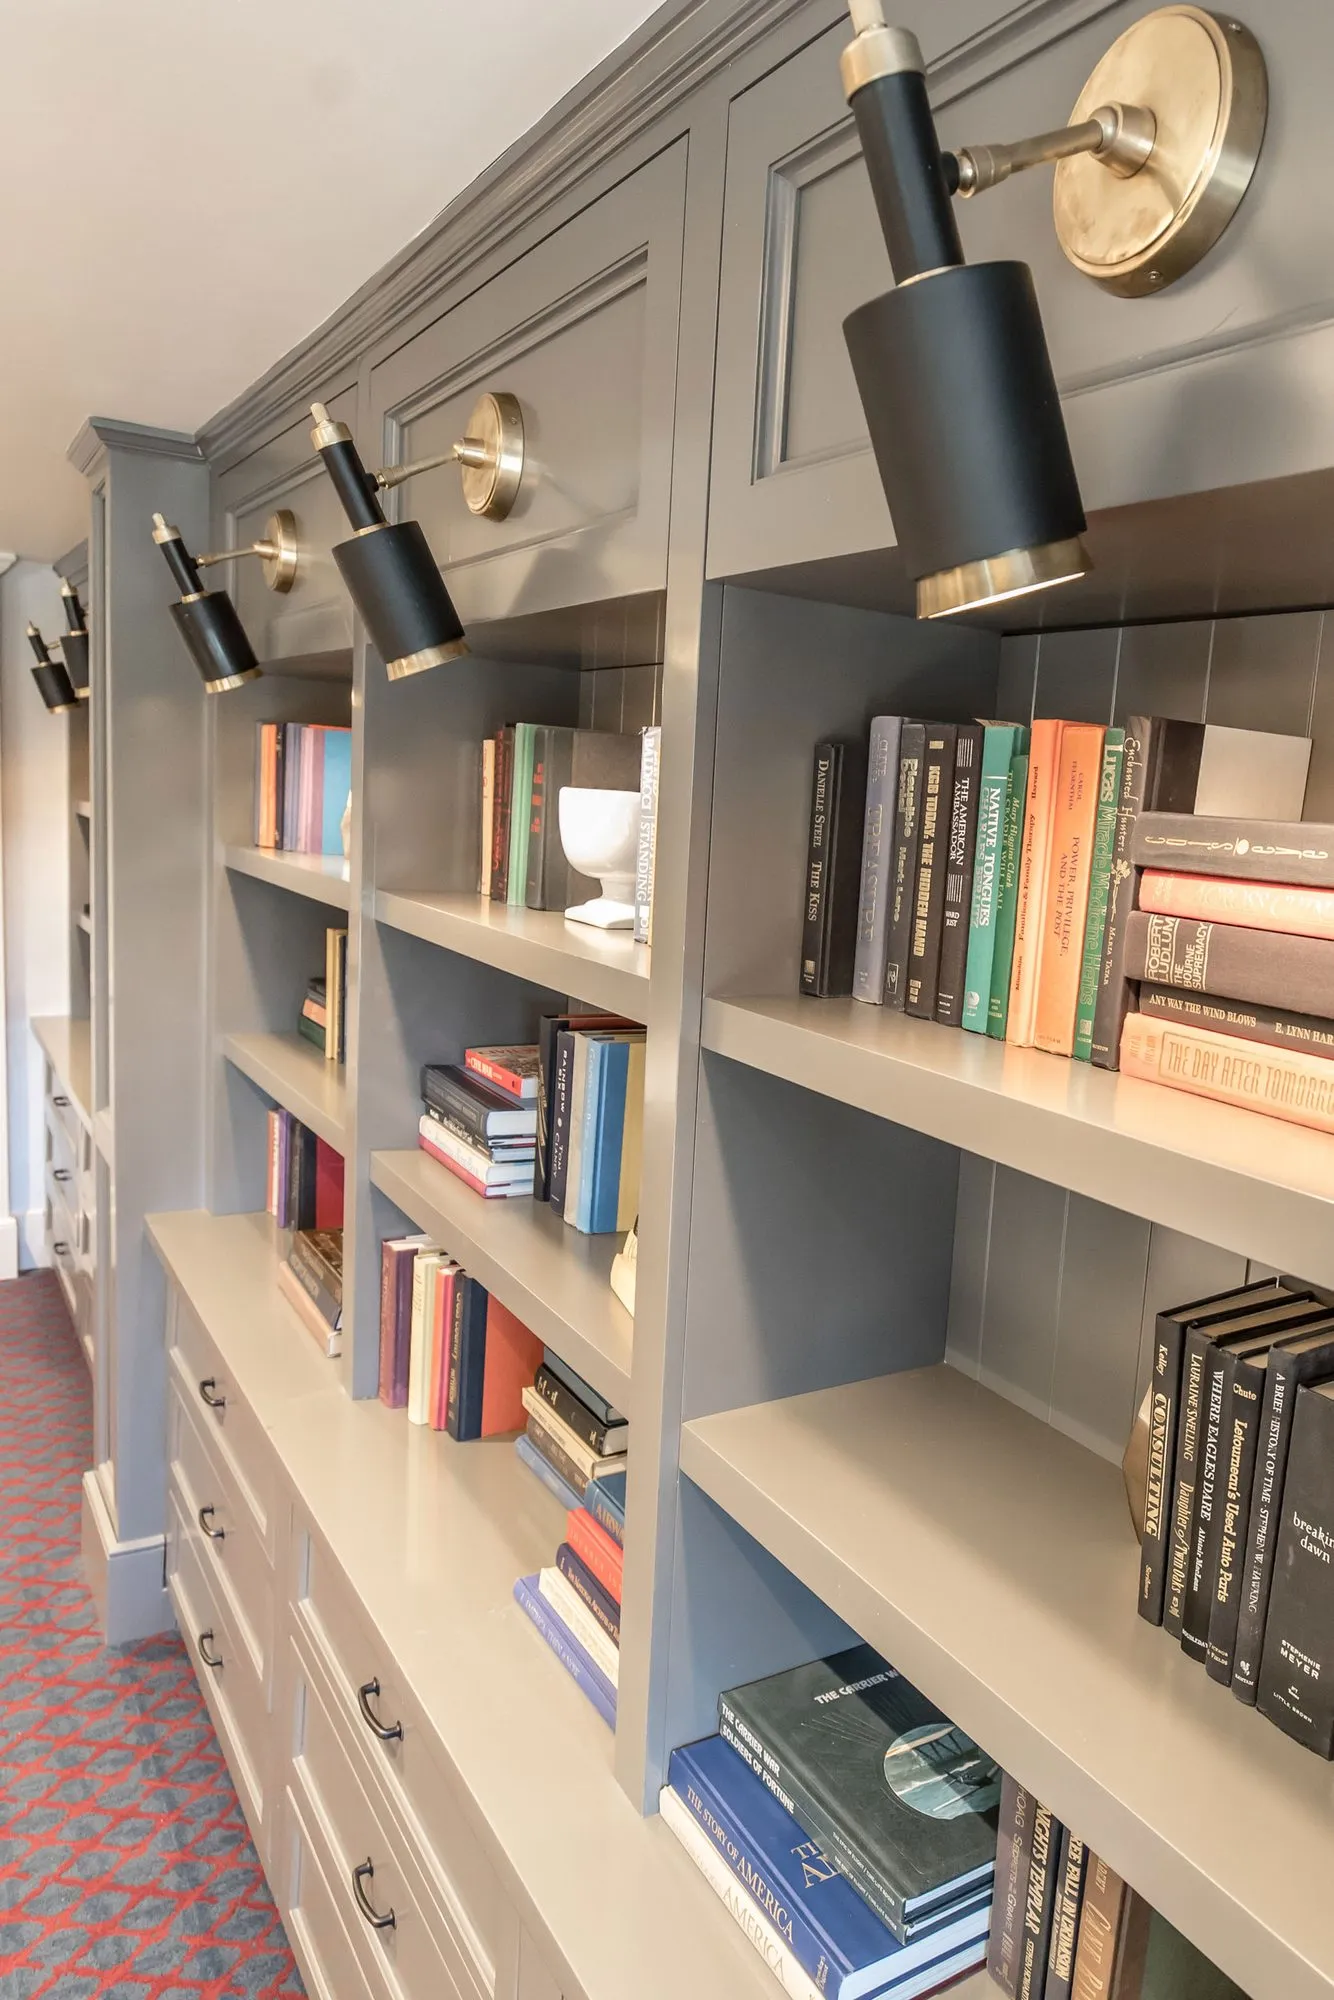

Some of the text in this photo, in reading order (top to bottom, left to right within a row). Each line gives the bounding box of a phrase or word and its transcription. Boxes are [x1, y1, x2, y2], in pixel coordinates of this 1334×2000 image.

[812, 759, 830, 848] DANIELLE STEEL
[904, 758, 919, 838] Plausible
[927, 765, 941, 794] KGB
[1031, 766, 1039, 799] Harvard
[1116, 737, 1143, 853] Enchanted Hunters
[921, 842, 934, 866] THE
[950, 781, 961, 860] AMBASSADOR
[956, 777, 970, 866] THE AMERICAN
[976, 786, 990, 860] CHARLES
[1005, 797, 1020, 888] Mary Higgins Clark
[637, 821, 651, 902] STANDING
[808, 860, 822, 921] THE KISS
[860, 803, 884, 941] TREASURE
[894, 846, 907, 922] Mark Lane
[979, 787, 1001, 927] NATIVE TONGUES
[1079, 744, 1124, 1006] Lucas Miracle Medicine Herbs
[917, 867, 932, 917] HIDDEN
[1053, 853, 1068, 936] AND THE POST
[1059, 836, 1080, 957] POWER, PRIVILEGE,
[913, 918, 927, 957] HAND
[1103, 926, 1117, 986] MARIA TATAR
[1147, 914, 1164, 981] ROBERT
[1158, 917, 1177, 984] LUDLUM
[1183, 943, 1196, 988] BOURNE
[1192, 922, 1210, 990] SUPREMACY
[1173, 963, 1184, 985] THE
[1149, 993, 1257, 1028] ANY WAY THE WIND BLOWS
[1275, 1022, 1285, 1034] E.
[1285, 1024, 1311, 1041] LYNN
[560, 1049, 568, 1113] RAINBOW
[1167, 1041, 1189, 1075] THE
[1191, 1047, 1219, 1084] DAY
[1220, 1055, 1262, 1095] AFTER
[1156, 1344, 1168, 1376] Kelley
[1232, 1382, 1257, 1401] Chute
[1183, 1353, 1203, 1461] LAURAINE SNELLING
[1261, 1372, 1286, 1504] A BRIEF HISTORY OF TIME
[1146, 1393, 1167, 1537] CONSULTING
[1200, 1369, 1225, 1521] WHERE EAGLES DARE
[1171, 1480, 1194, 1594] Daughter of Twin Oaks
[1196, 1526, 1206, 1558] Alistair
[1217, 1418, 1248, 1603] Letourneau's Used Auto Parts
[1248, 1508, 1269, 1614] STEPHEN W. HAWKING
[1300, 1535, 1331, 1564] dawn
[1280, 1648, 1320, 1680] MEYER
[1281, 1639, 1321, 1671] STEPHENIE
[814, 1690, 841, 1705] THE
[841, 1673, 888, 1696] CARRIER
[722, 1703, 780, 1778] THE CARRIER WAR
[722, 1725, 795, 1814] SOLDIERS OF FORTUNE
[1015, 1785, 1027, 1828] HOAG
[687, 1785, 795, 1945] THE STORY OF AMERICA
[1009, 1833, 1023, 1884] SECRETS
[1025, 1801, 1052, 1935] NIGHTS TEMPLAR
[1064, 1861, 1080, 1898] FALL
[1068, 1833, 1083, 1865] REE
[721, 1886, 786, 1982] AMERICA
[1005, 1893, 1017, 1932] GRAVE
[1062, 1896, 1077, 1918] IN
[1055, 1913, 1075, 1982] CRIMSON
